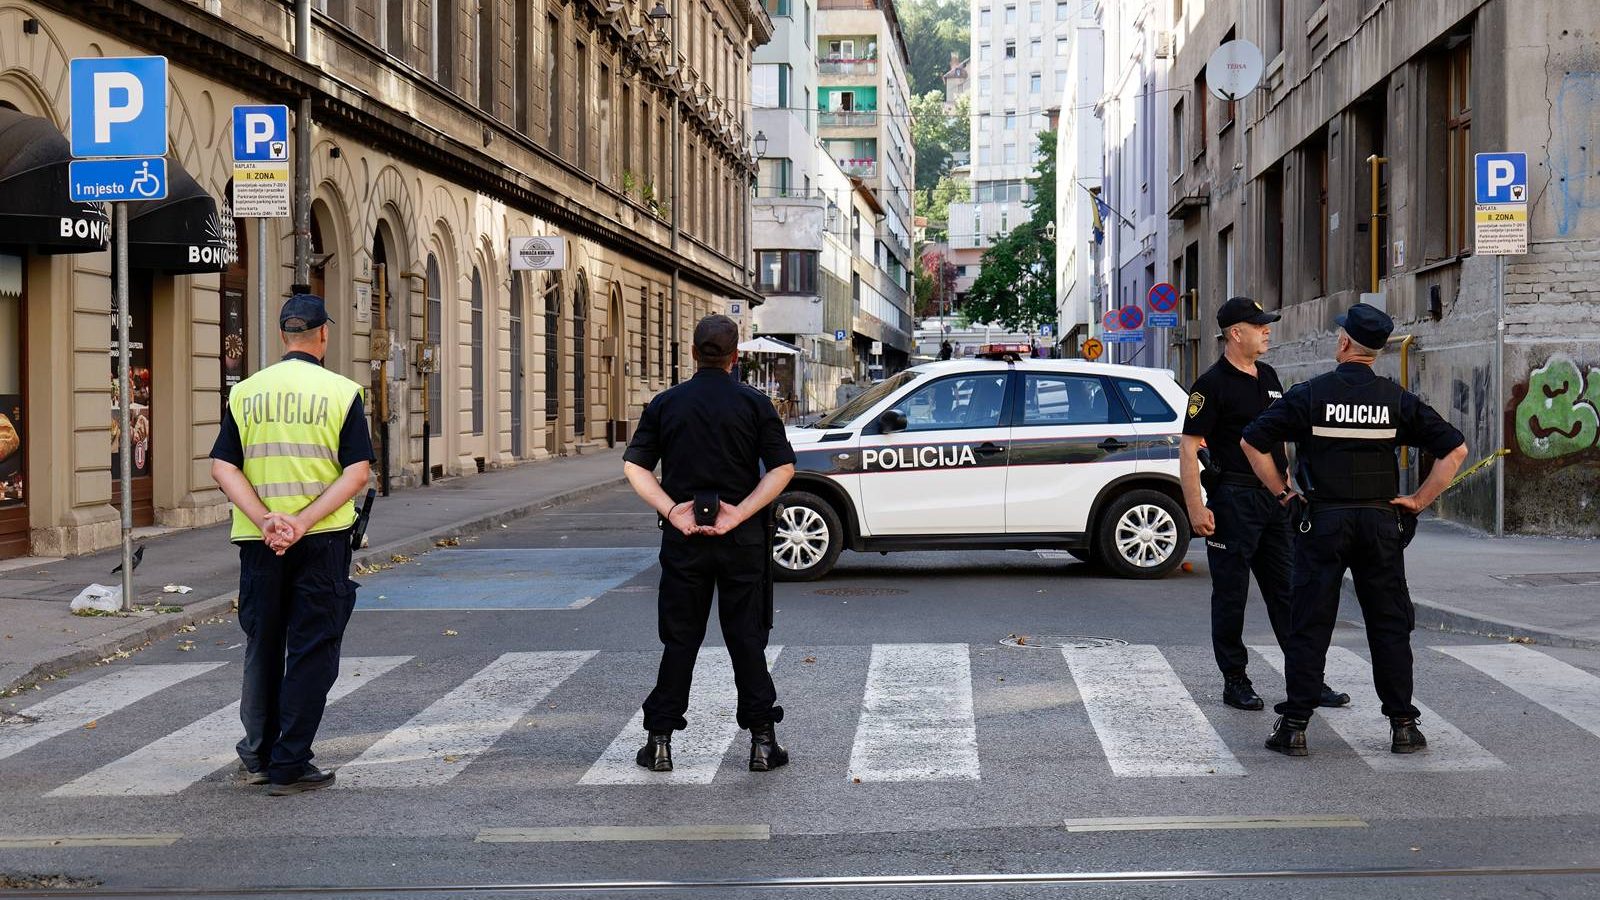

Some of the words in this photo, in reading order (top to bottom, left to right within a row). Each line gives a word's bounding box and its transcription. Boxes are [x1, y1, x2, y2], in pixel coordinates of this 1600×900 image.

[94, 72, 144, 143] P
[246, 114, 274, 154] P
[76, 182, 81, 195] 1
[83, 182, 124, 197] mjesto
[1488, 160, 1515, 197] P
[1043, 326, 1049, 335] P
[243, 392, 328, 427] POLICIJA
[1326, 404, 1390, 424] POLICIJA
[862, 445, 976, 470] POLICIJA
